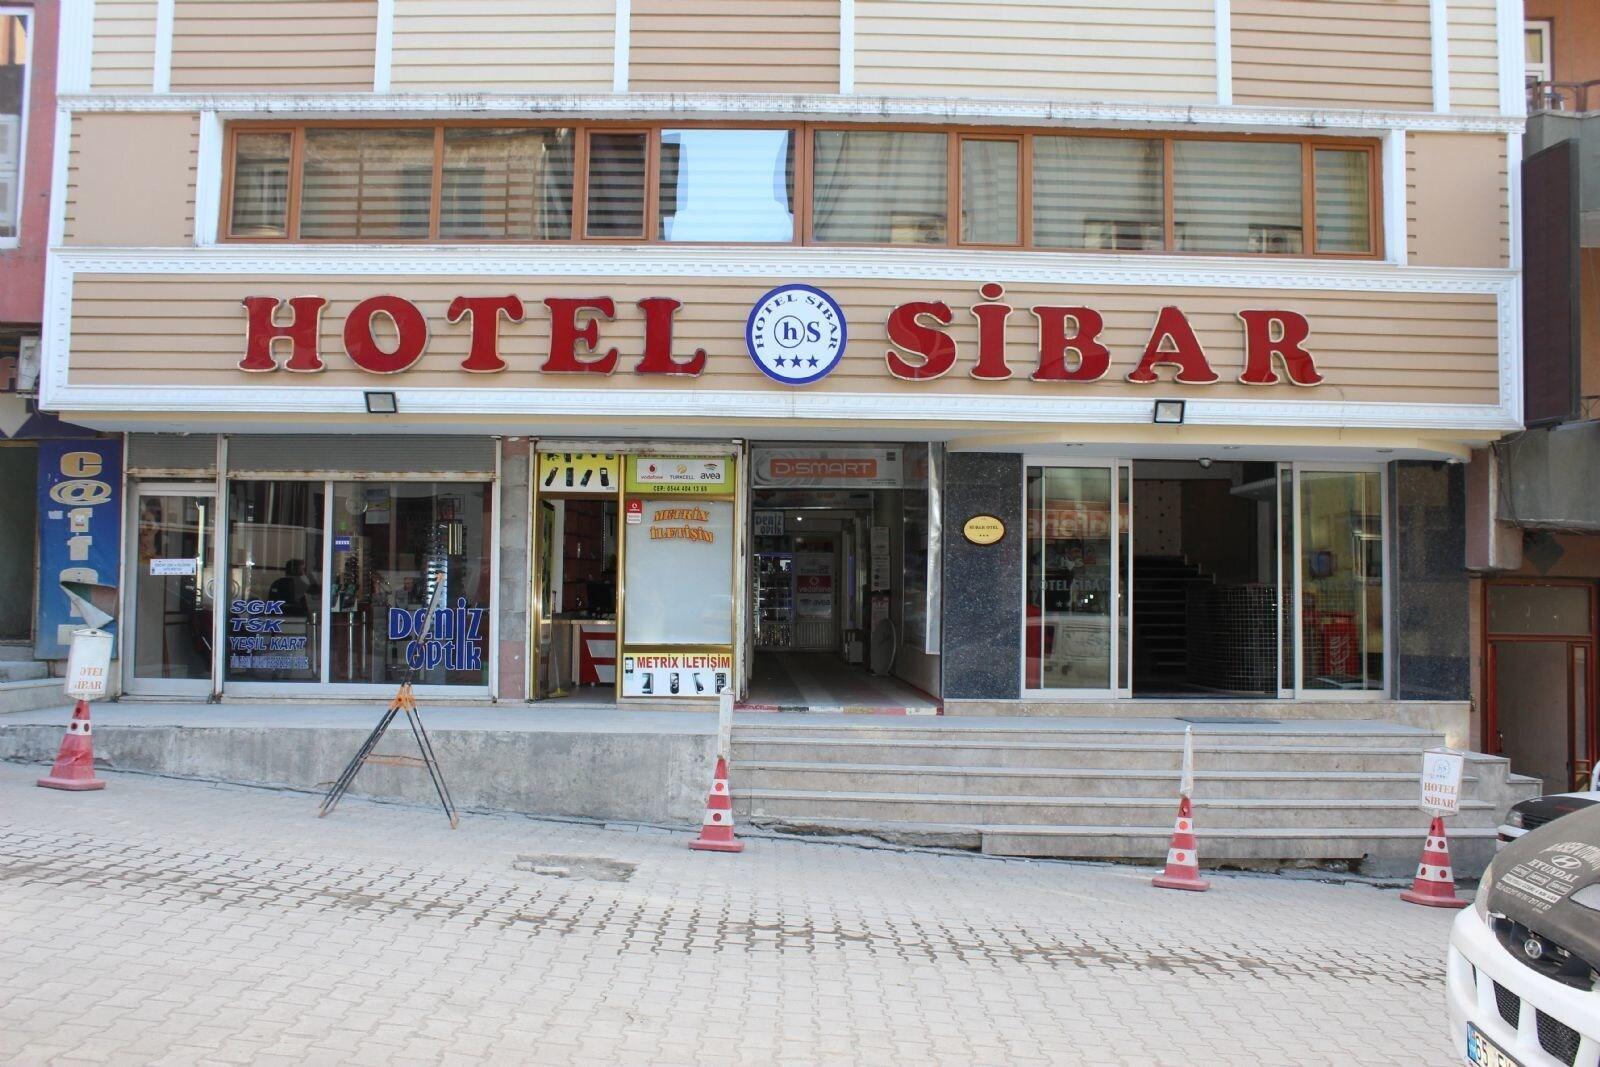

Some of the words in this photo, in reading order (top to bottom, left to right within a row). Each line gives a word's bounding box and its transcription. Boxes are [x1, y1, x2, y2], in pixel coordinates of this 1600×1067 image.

[755, 293, 798, 349] HOTEL
[237, 294, 708, 378] HOTEL
[884, 282, 1325, 387] SİBAR
[700, 472, 721, 480] avea
[229, 600, 286, 615] SGK
[230, 618, 286, 633] TSK
[229, 634, 267, 653] YEŞİL
[269, 636, 307, 651] KART
[637, 654, 679, 669] METRİX
[682, 653, 731, 671] İLETİŞİM
[1424, 782, 1457, 796] HOTEL
[1526, 858, 1580, 883] HYUNDAI
